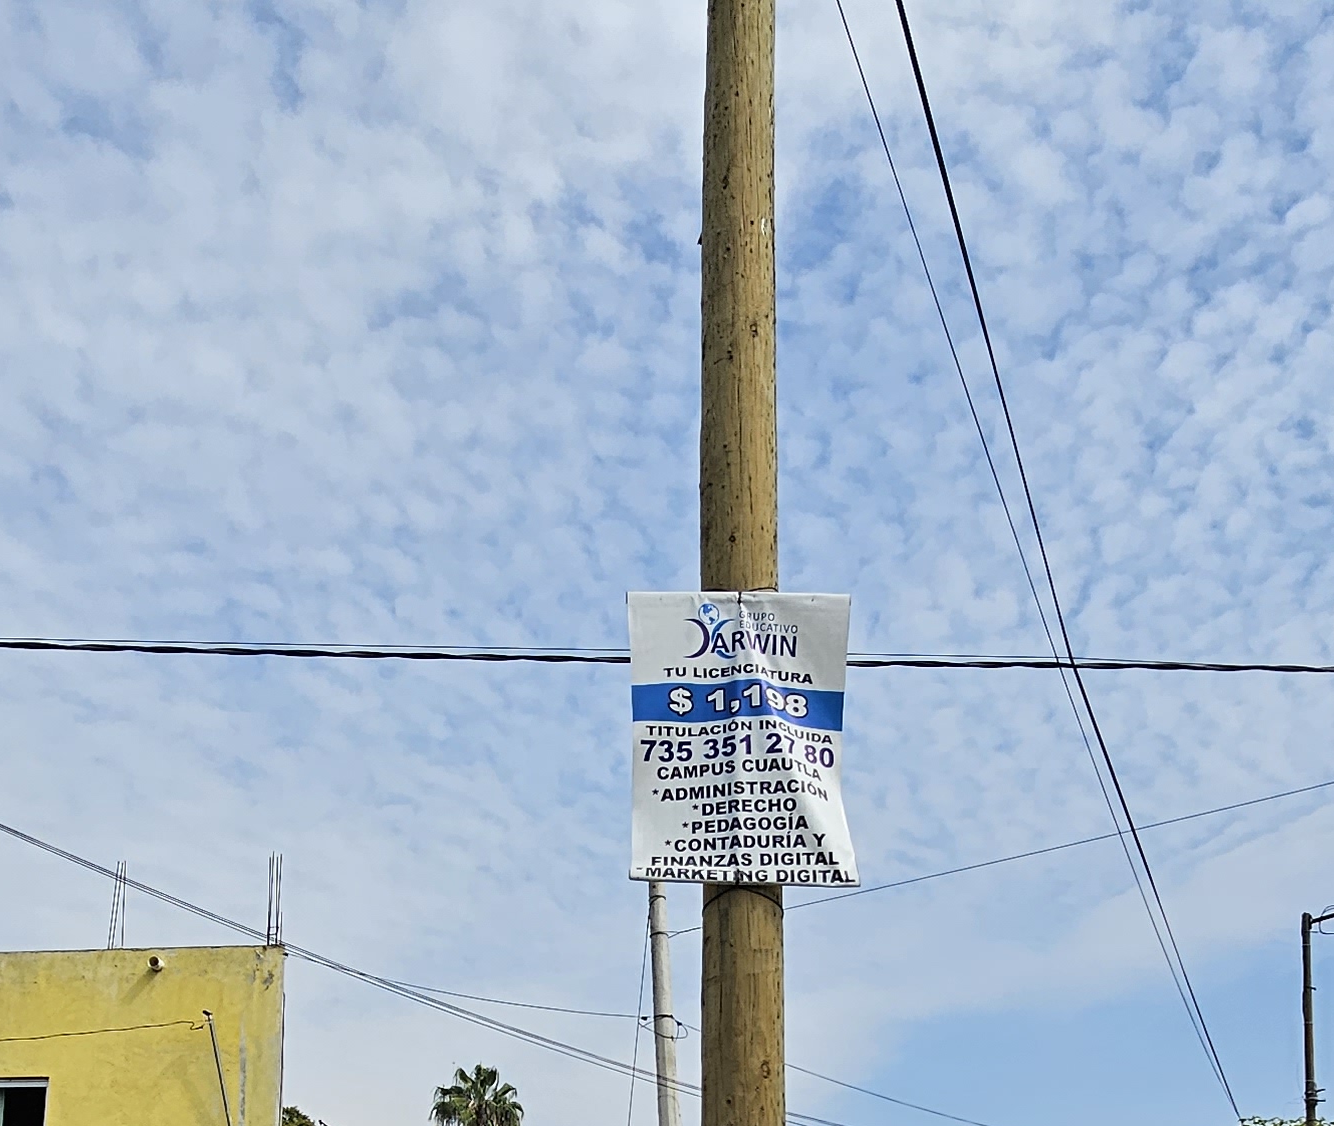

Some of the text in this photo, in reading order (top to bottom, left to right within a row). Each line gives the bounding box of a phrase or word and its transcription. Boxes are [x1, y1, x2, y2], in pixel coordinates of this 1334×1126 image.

[739, 611, 775, 622] GRUPO
[739, 621, 798, 634] EDUCATIVO
[663, 664, 814, 684] TU LICENCIATURA
[707, 683, 809, 718] 1,198
[646, 719, 833, 744] TITULACIÓN INCLUIDA
[640, 733, 835, 768] 735 351 27 80
[657, 757, 822, 782] CAMPUS CUAUTLA
[813, 834, 826, 847] Y
[651, 851, 840, 867] FINANZAS DIGITAL
[776, 869, 856, 883] DIGITAL
